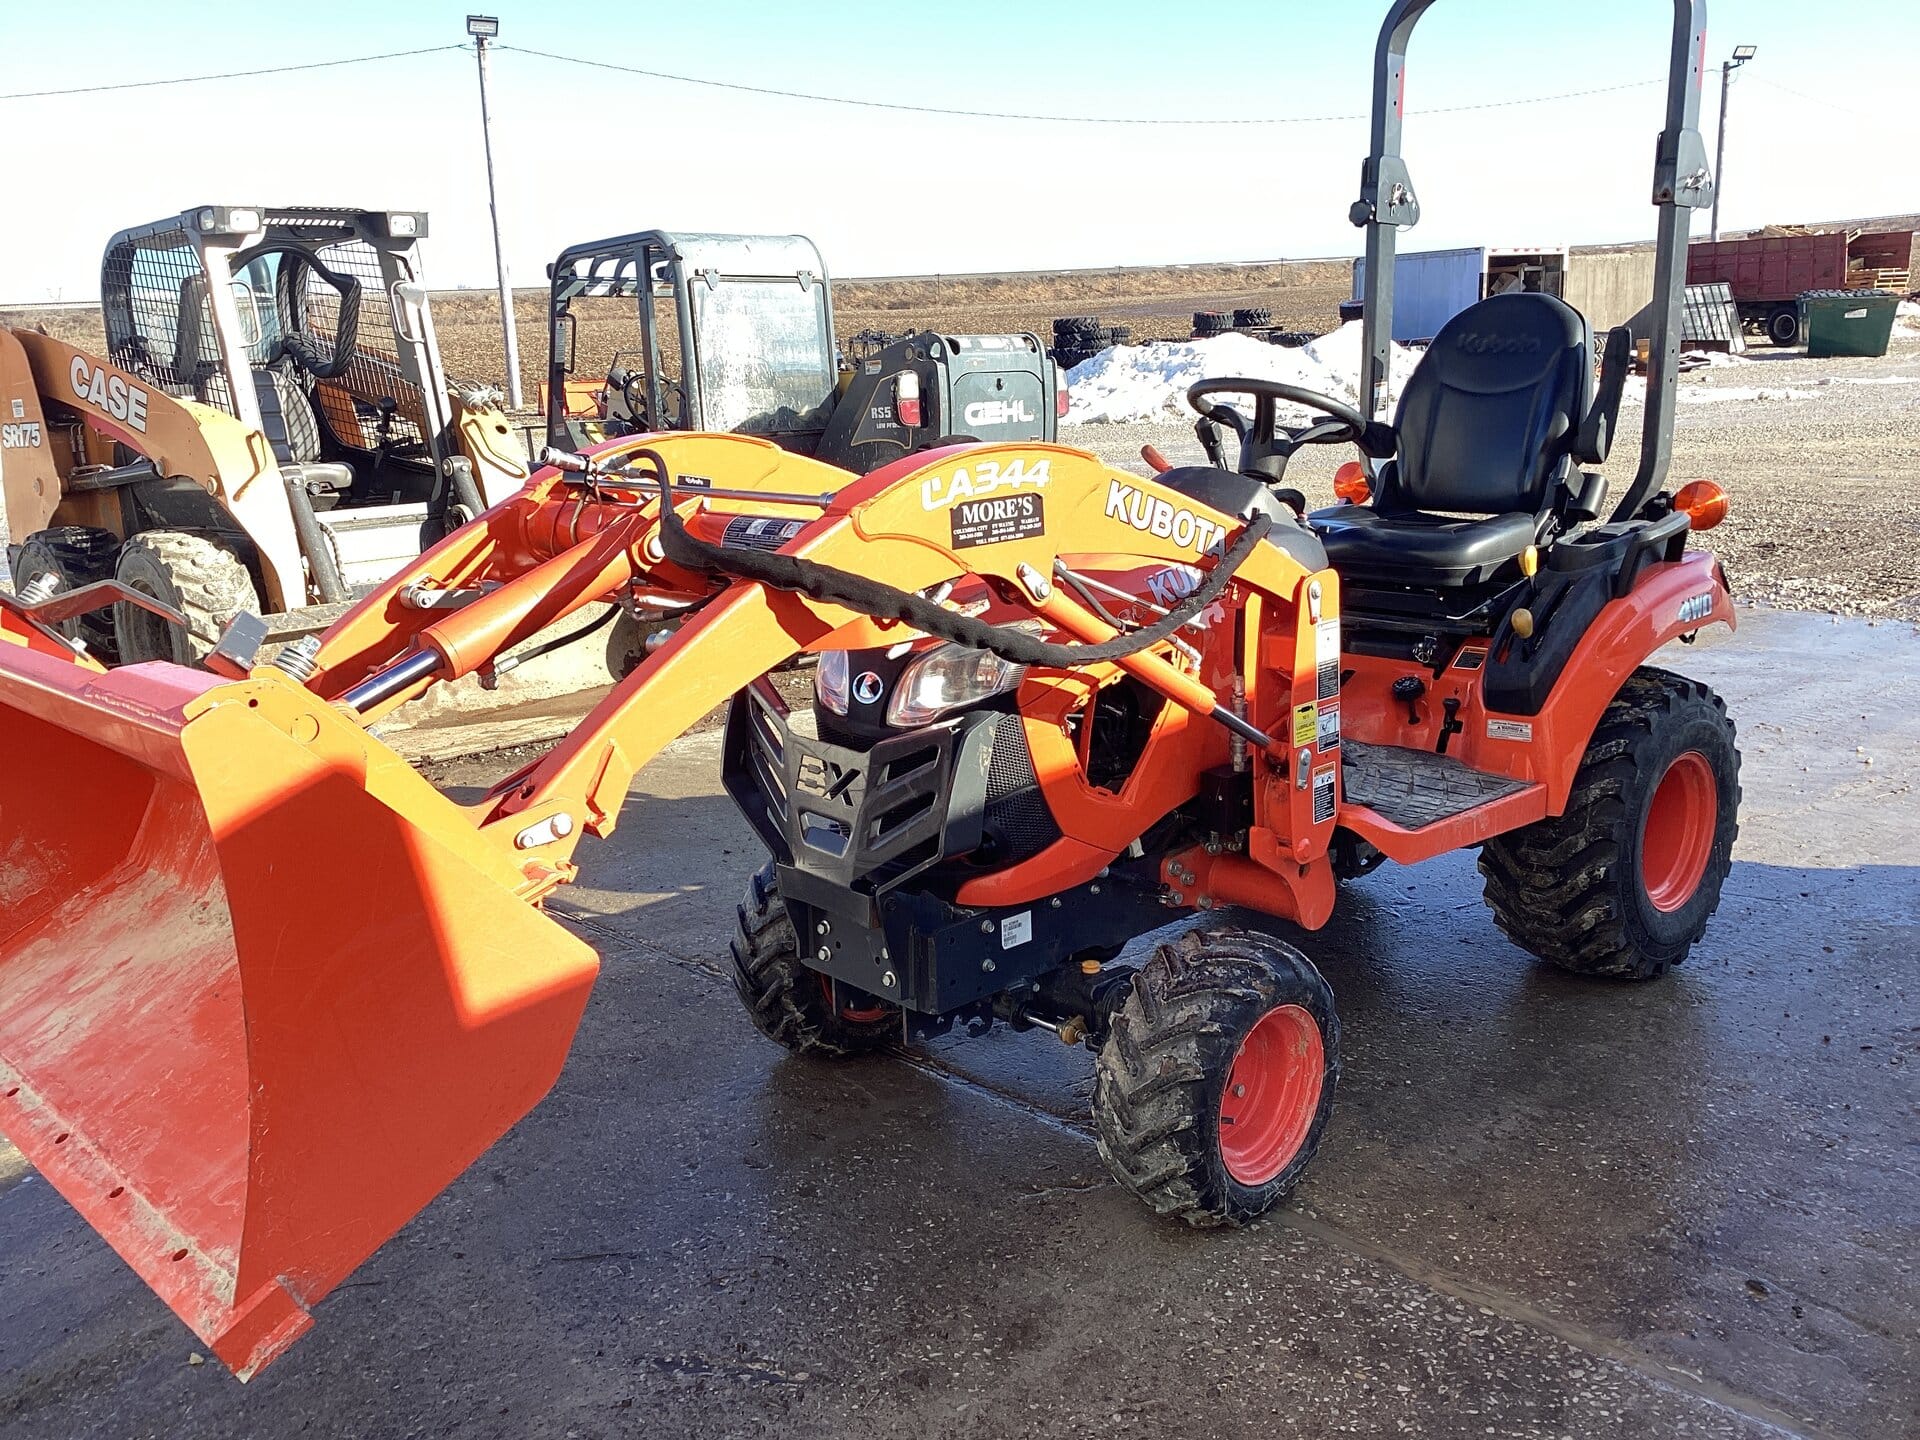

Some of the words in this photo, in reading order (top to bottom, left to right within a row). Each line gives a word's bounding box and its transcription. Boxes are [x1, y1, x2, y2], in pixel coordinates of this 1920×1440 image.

[70, 355, 148, 434] CASE
[964, 400, 1034, 427] GEHL
[2, 421, 41, 449] SR175
[921, 459, 1050, 512] LA344
[962, 496, 1033, 524] MORE'S
[1105, 479, 1226, 562] KUBOTA
[1677, 592, 1713, 623] 4WD
[796, 753, 861, 807] BX
